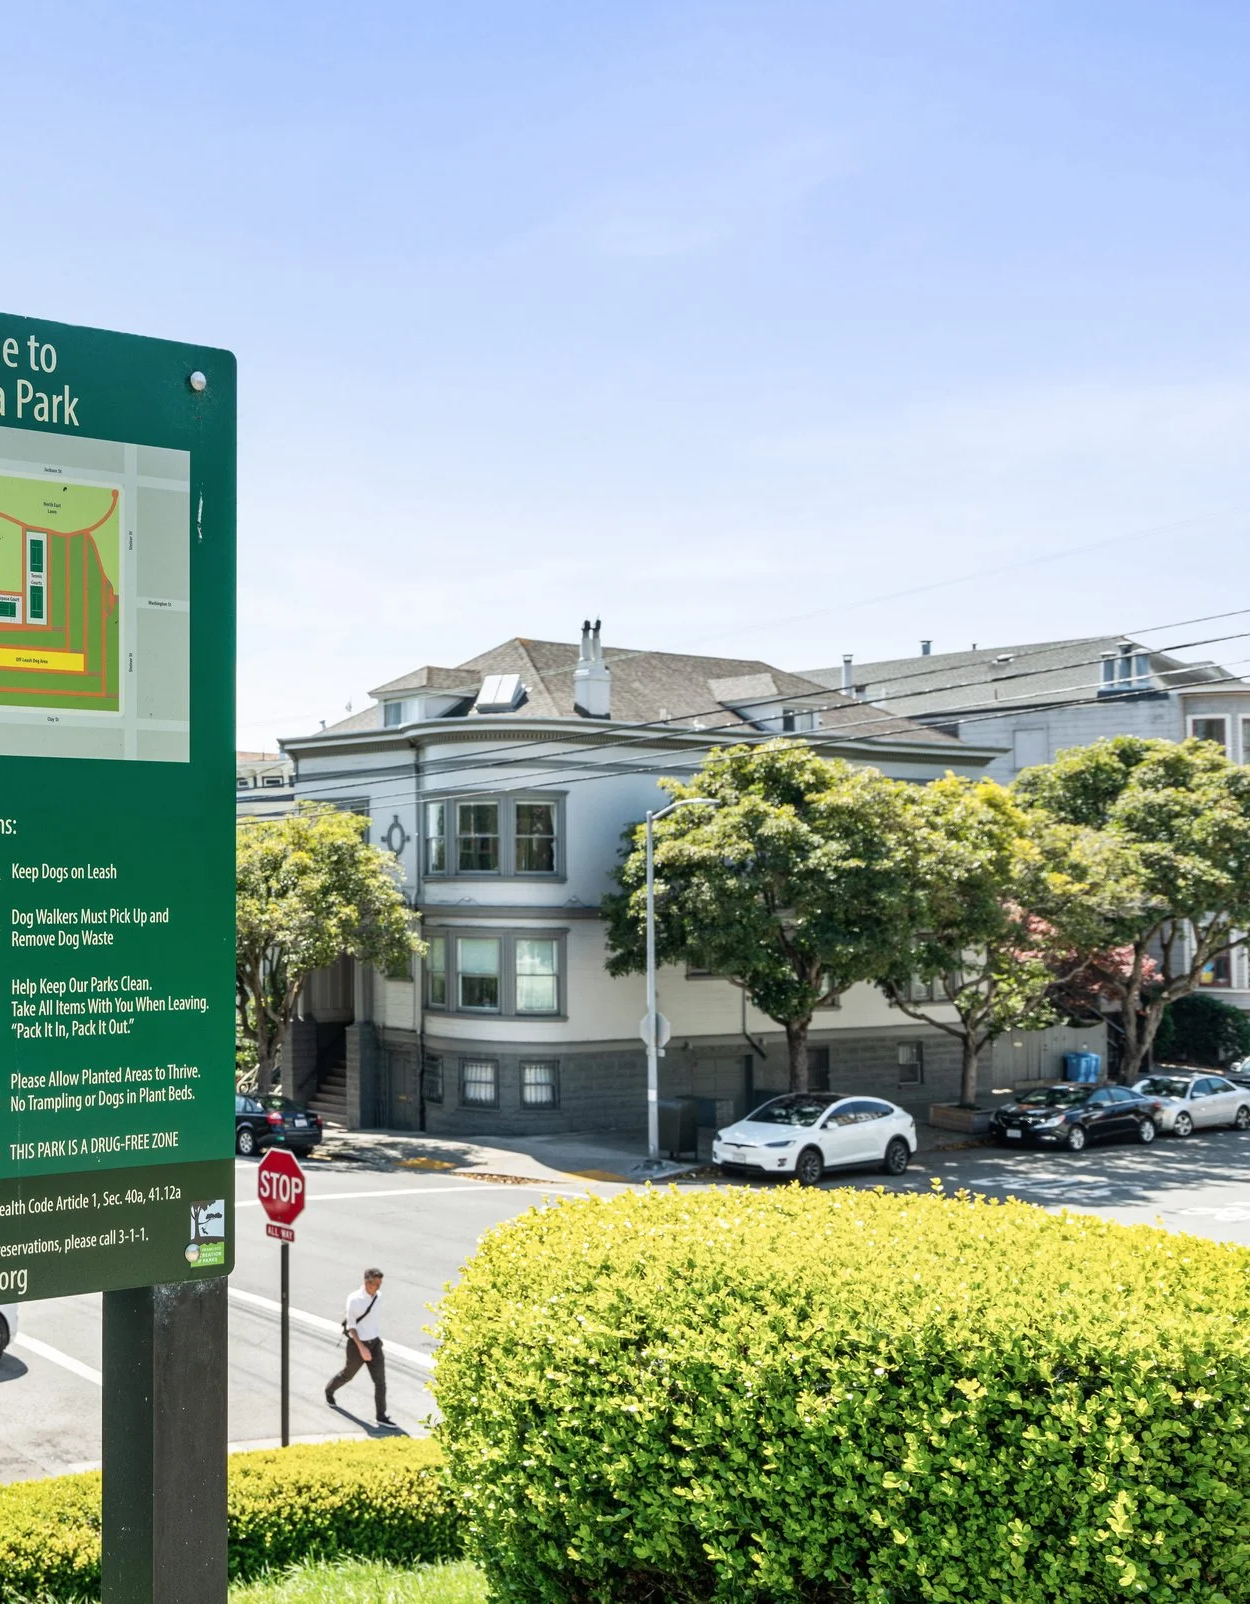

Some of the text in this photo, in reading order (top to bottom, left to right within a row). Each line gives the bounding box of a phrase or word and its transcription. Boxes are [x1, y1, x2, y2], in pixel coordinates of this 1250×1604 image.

[27, 335, 57, 373] to
[17, 379, 79, 426] Park
[12, 864, 116, 882] Keep Dogs on Leash
[12, 908, 168, 928] Dog Walkers Must Pick Up and
[12, 930, 113, 949] Remove Dog Waste
[12, 976, 151, 998] Help Keep Our Parks Clean.
[12, 996, 208, 1016] Take All Items With You When Leaving.
[12, 1018, 134, 1038] “Pack It In, Pack It Out.”
[11, 1064, 200, 1089] Please Allow Planted Areas to Thrive.
[11, 1085, 195, 1112] No Trampling or Dogs in Plant Beds.
[10, 1132, 178, 1160] THIS PARK IS A DRUG-FREE ZONE
[29, 1197, 53, 1213] Code
[56, 1194, 89, 1211] Article
[92, 1193, 100, 1208] 1,
[103, 1192, 122, 1206] Sec.
[125, 1189, 146, 1204] 40a,
[148, 1186, 182, 1202] 41.12a
[260, 1170, 302, 1204] STOP
[65, 1232, 97, 1254] please
[99, 1230, 116, 1246] call
[119, 1227, 149, 1244] 3-1-1.
[268, 1226, 293, 1240] ALL WAY
